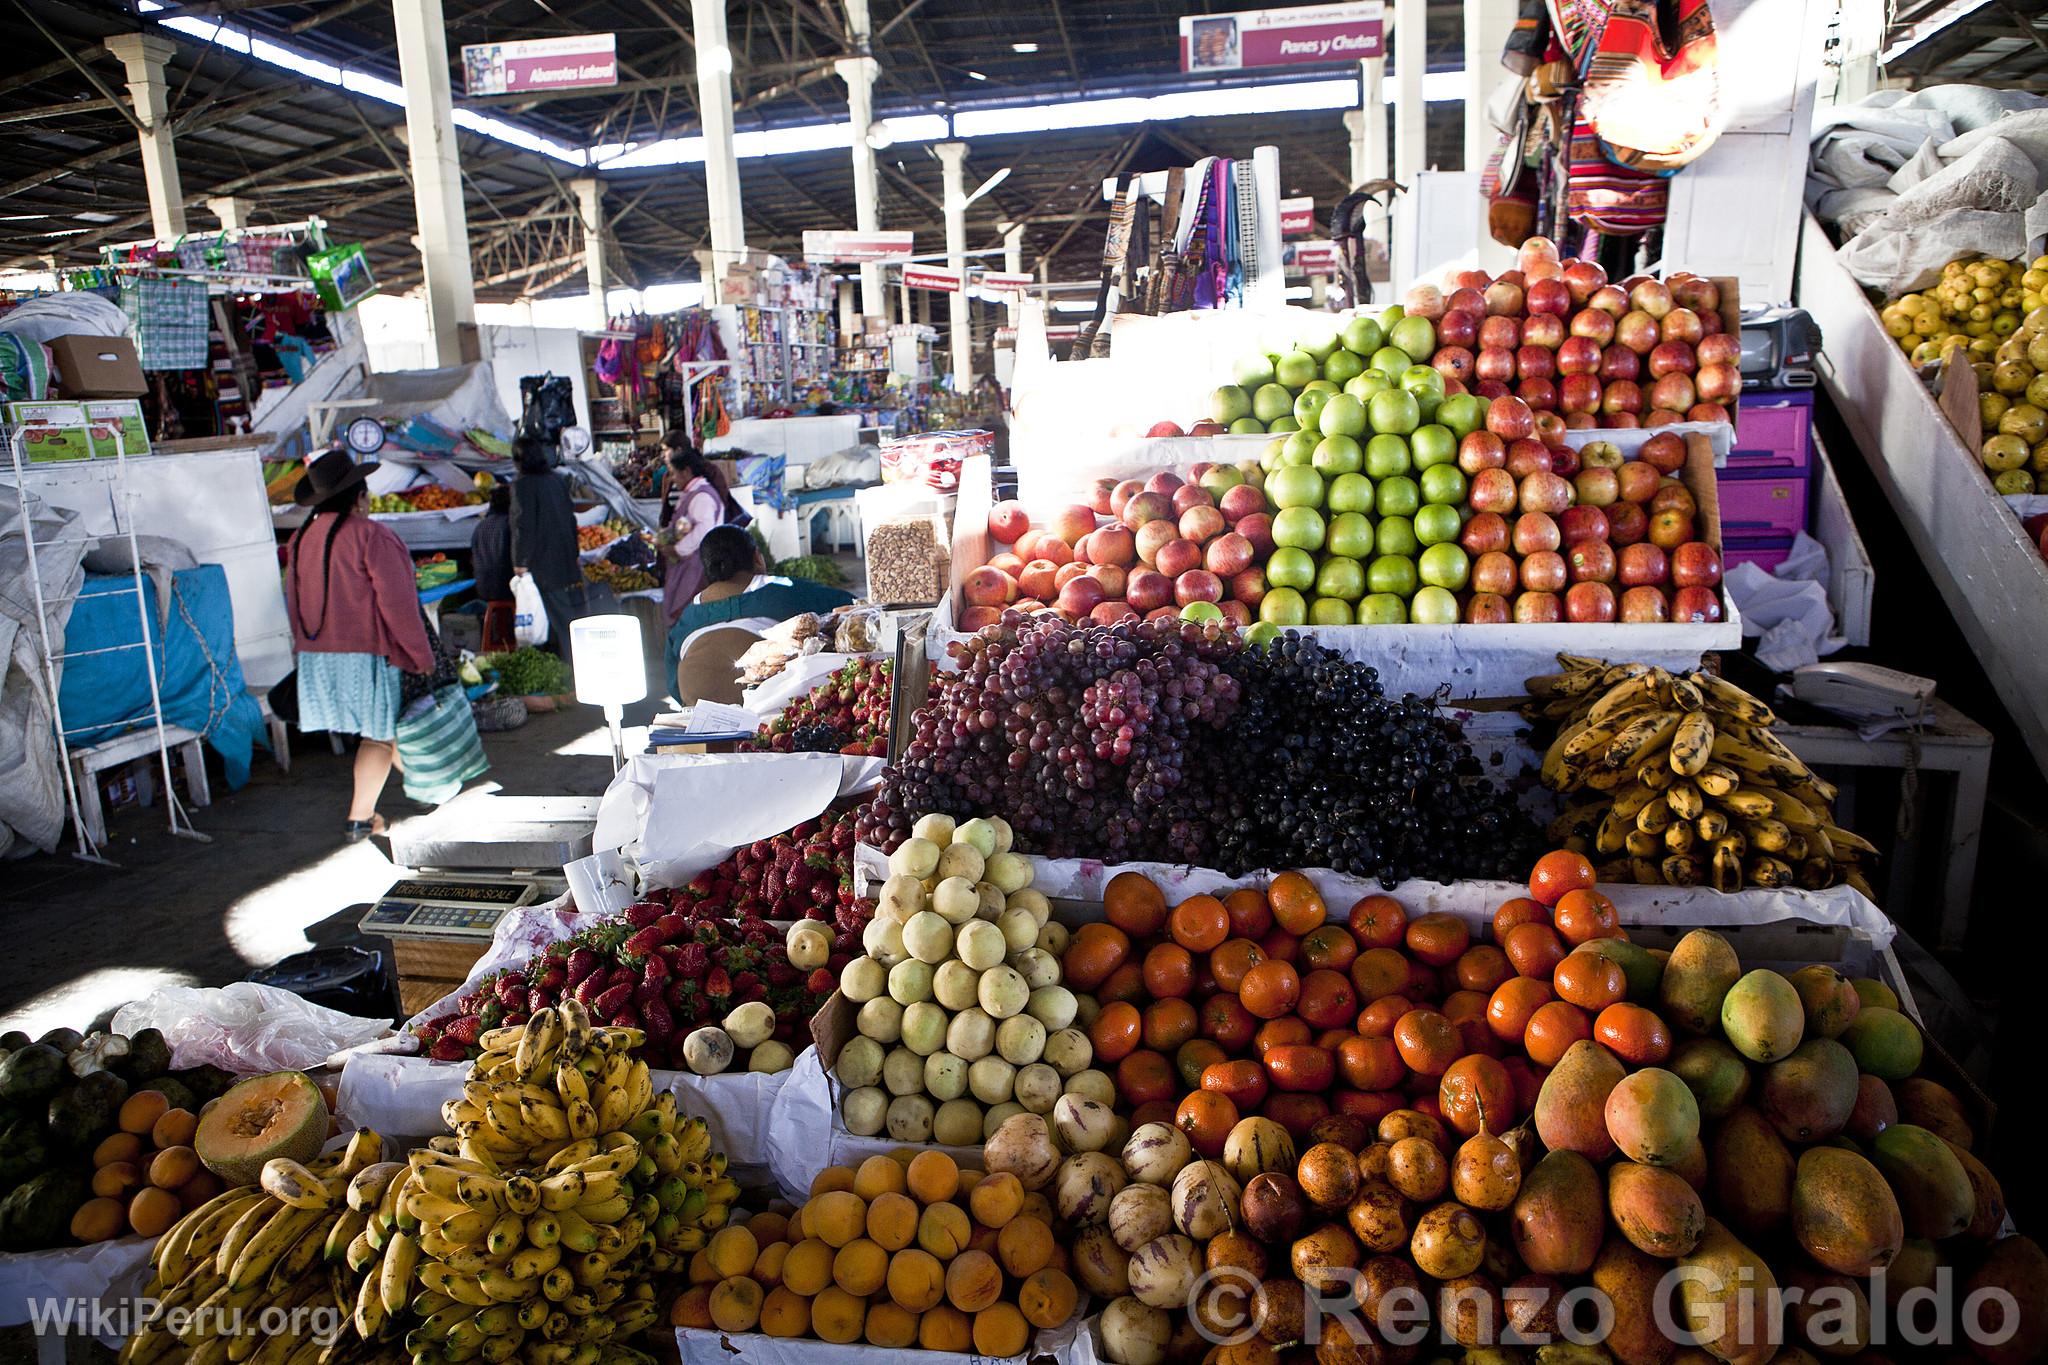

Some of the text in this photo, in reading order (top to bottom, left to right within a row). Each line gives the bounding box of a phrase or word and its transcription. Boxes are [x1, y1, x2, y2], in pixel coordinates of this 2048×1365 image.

[1280, 34, 1378, 56] Panes y Chutas
[529, 67, 578, 83] Abarrotes
[579, 62, 615, 80] Lateral
[395, 883, 516, 900] DIGITAL ELECTRONIC SCALE
